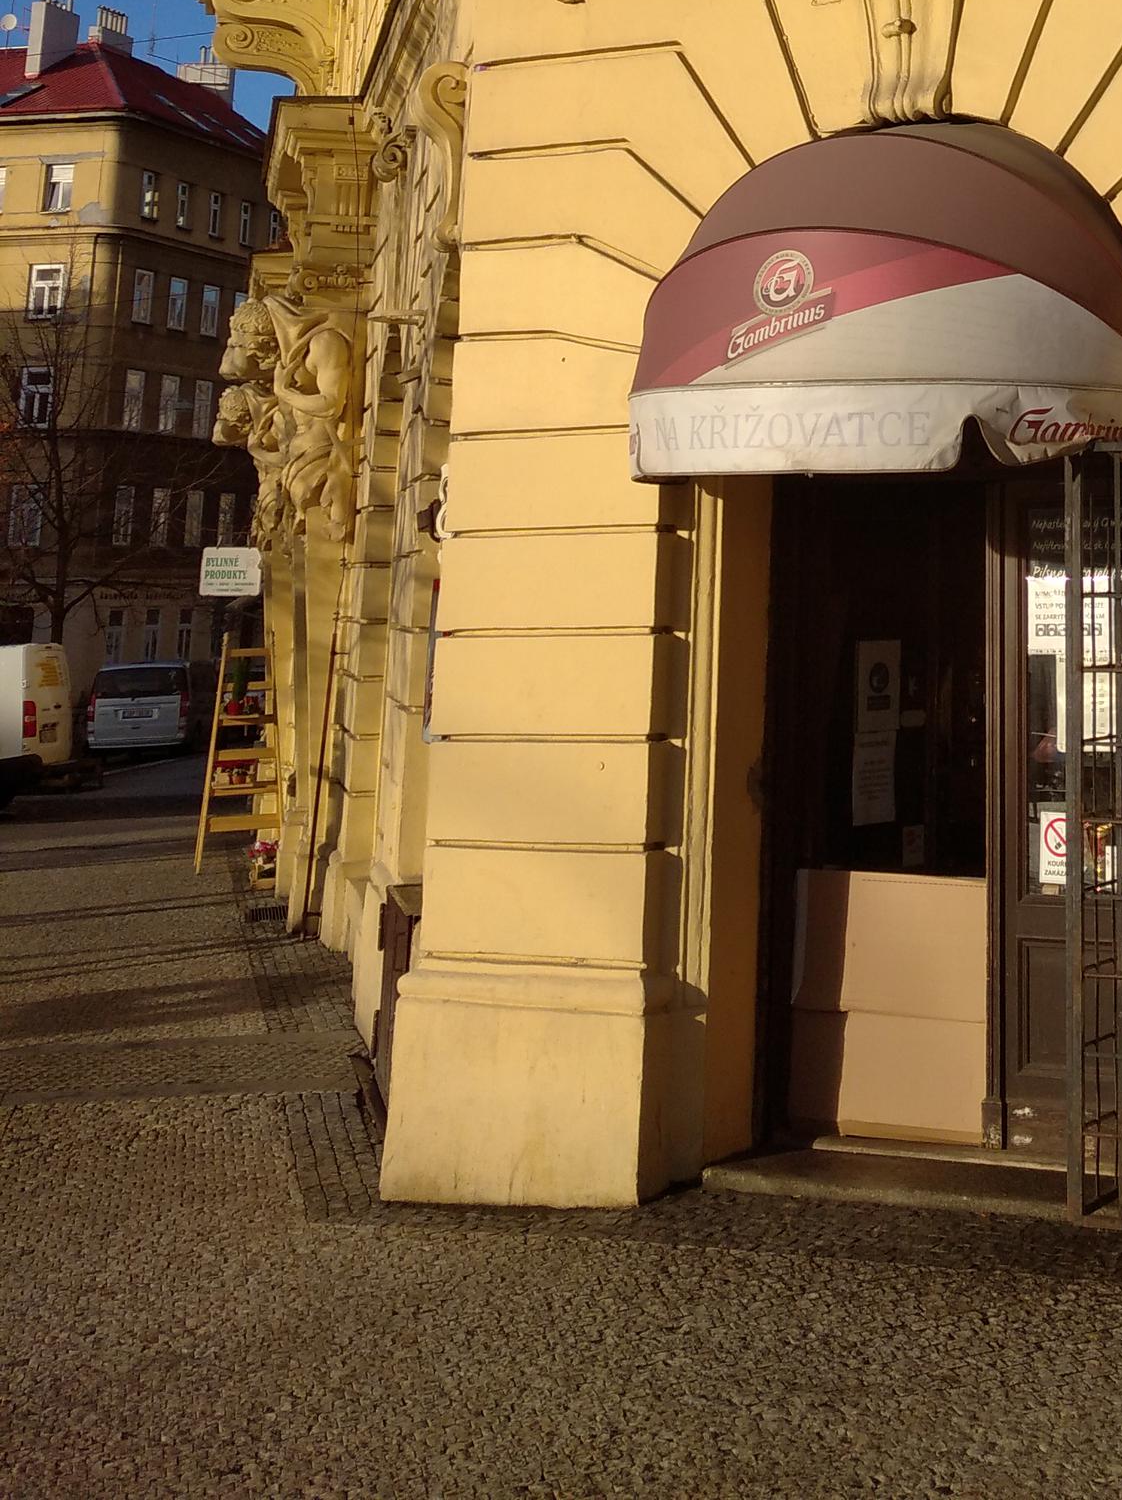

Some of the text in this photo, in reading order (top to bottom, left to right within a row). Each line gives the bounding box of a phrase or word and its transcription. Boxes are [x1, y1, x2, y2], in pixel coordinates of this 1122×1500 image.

[727, 304, 825, 359] Gambrinus
[654, 415, 681, 452] NA
[688, 404, 931, 450] KŘIŽOVATCE
[204, 570, 248, 580] PRODUKTY
[205, 555, 240, 567] BYLINNÉ
